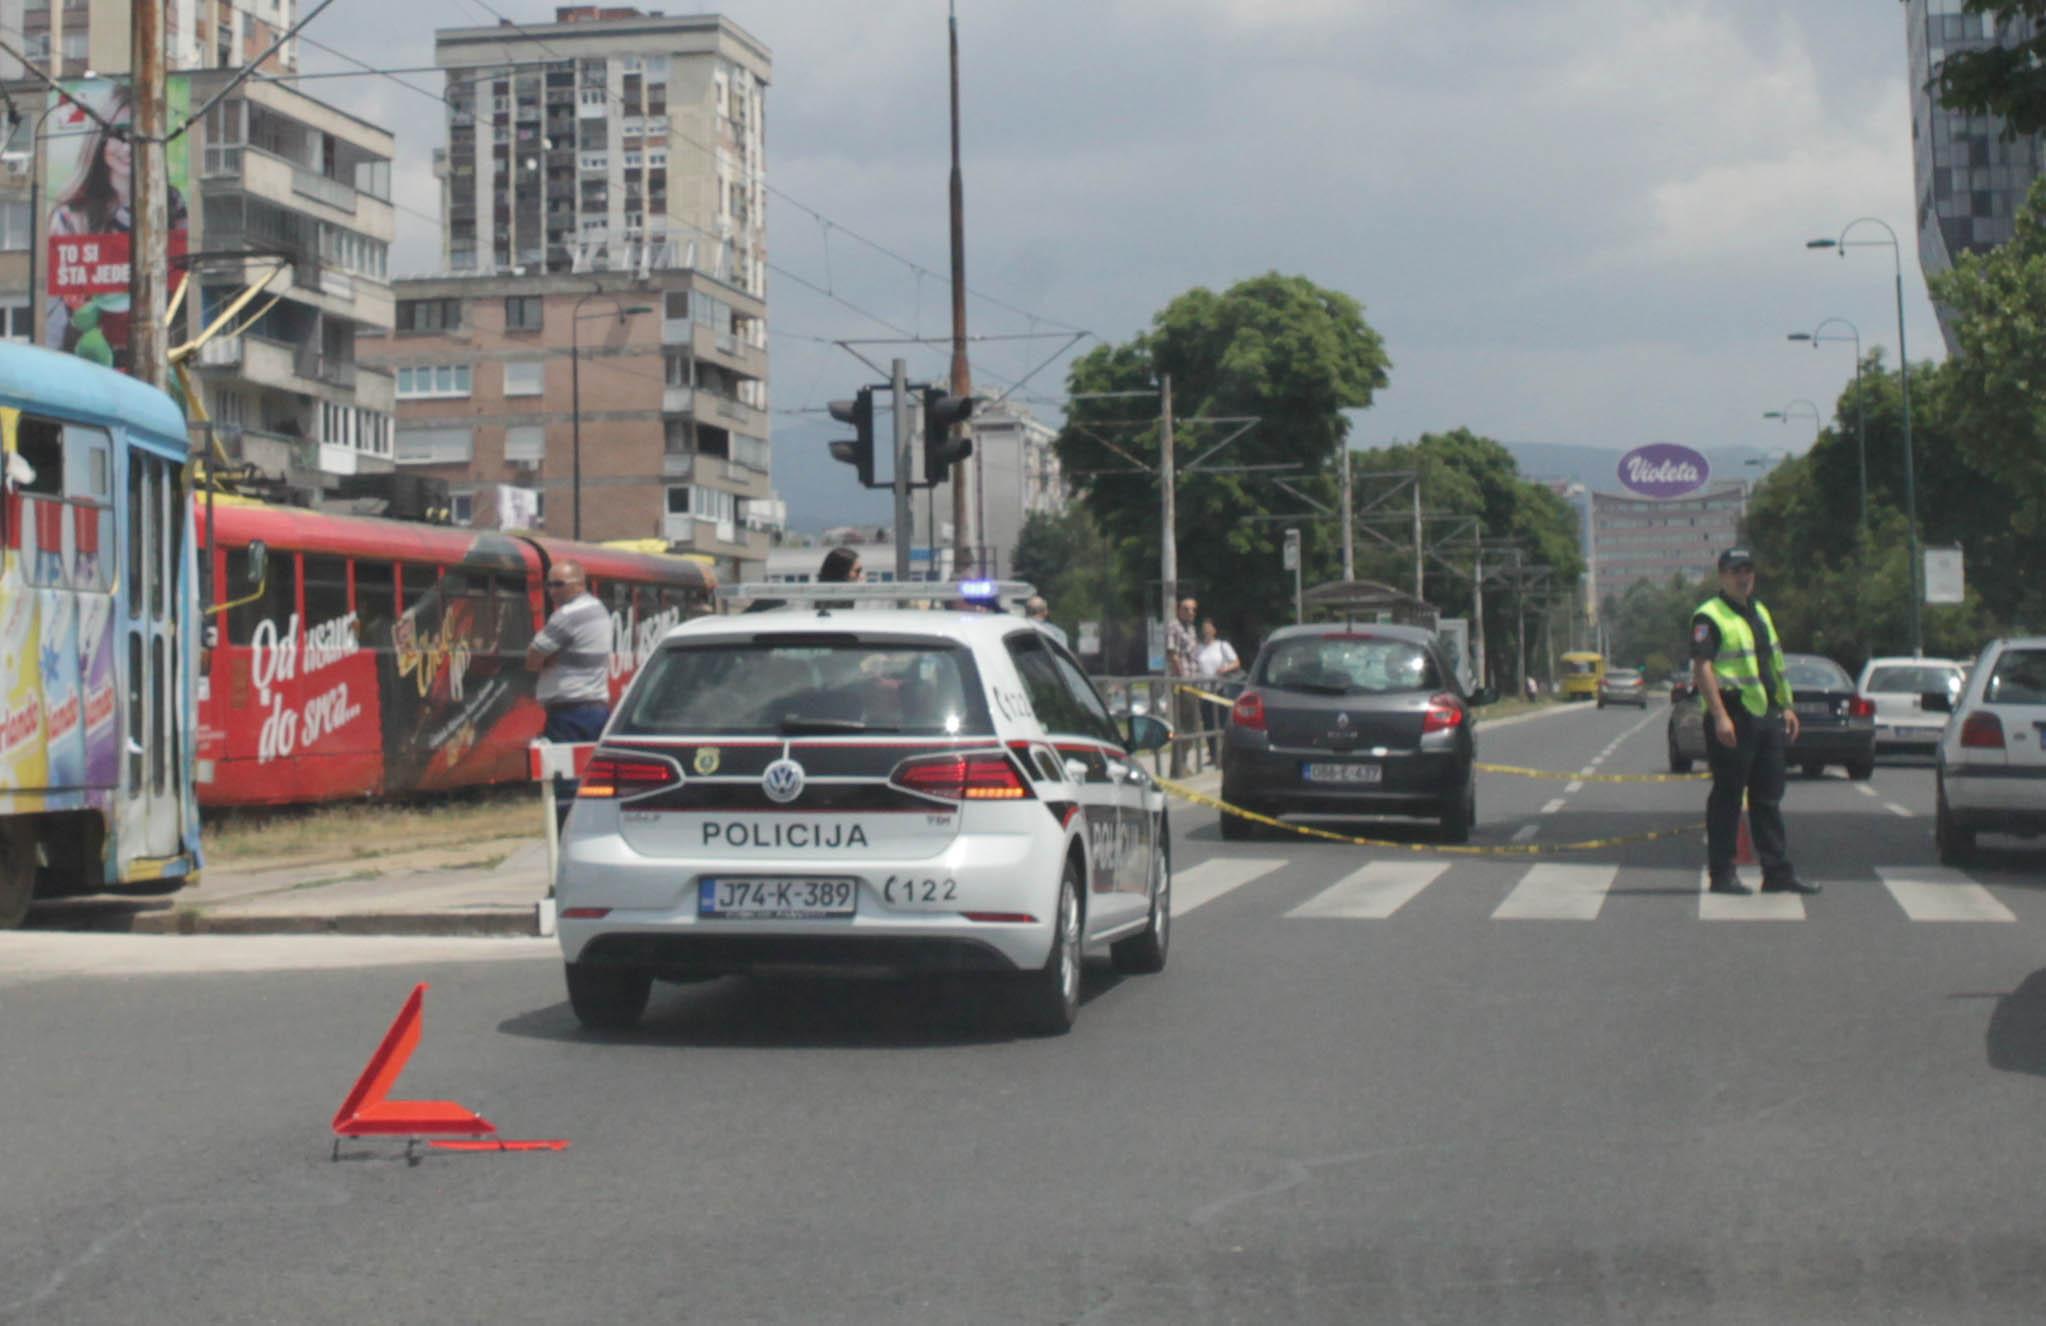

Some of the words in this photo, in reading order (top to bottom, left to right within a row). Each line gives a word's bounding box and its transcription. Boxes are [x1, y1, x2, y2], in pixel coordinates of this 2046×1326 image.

[57, 244, 78, 263] TO
[82, 243, 99, 263] SI
[92, 264, 131, 284] JEDE
[1627, 456, 1698, 483] Violeta
[258, 693, 299, 764] do
[702, 822, 868, 847] POLICIJA
[719, 882, 850, 908] J74-K-389
[903, 879, 957, 902] 122
